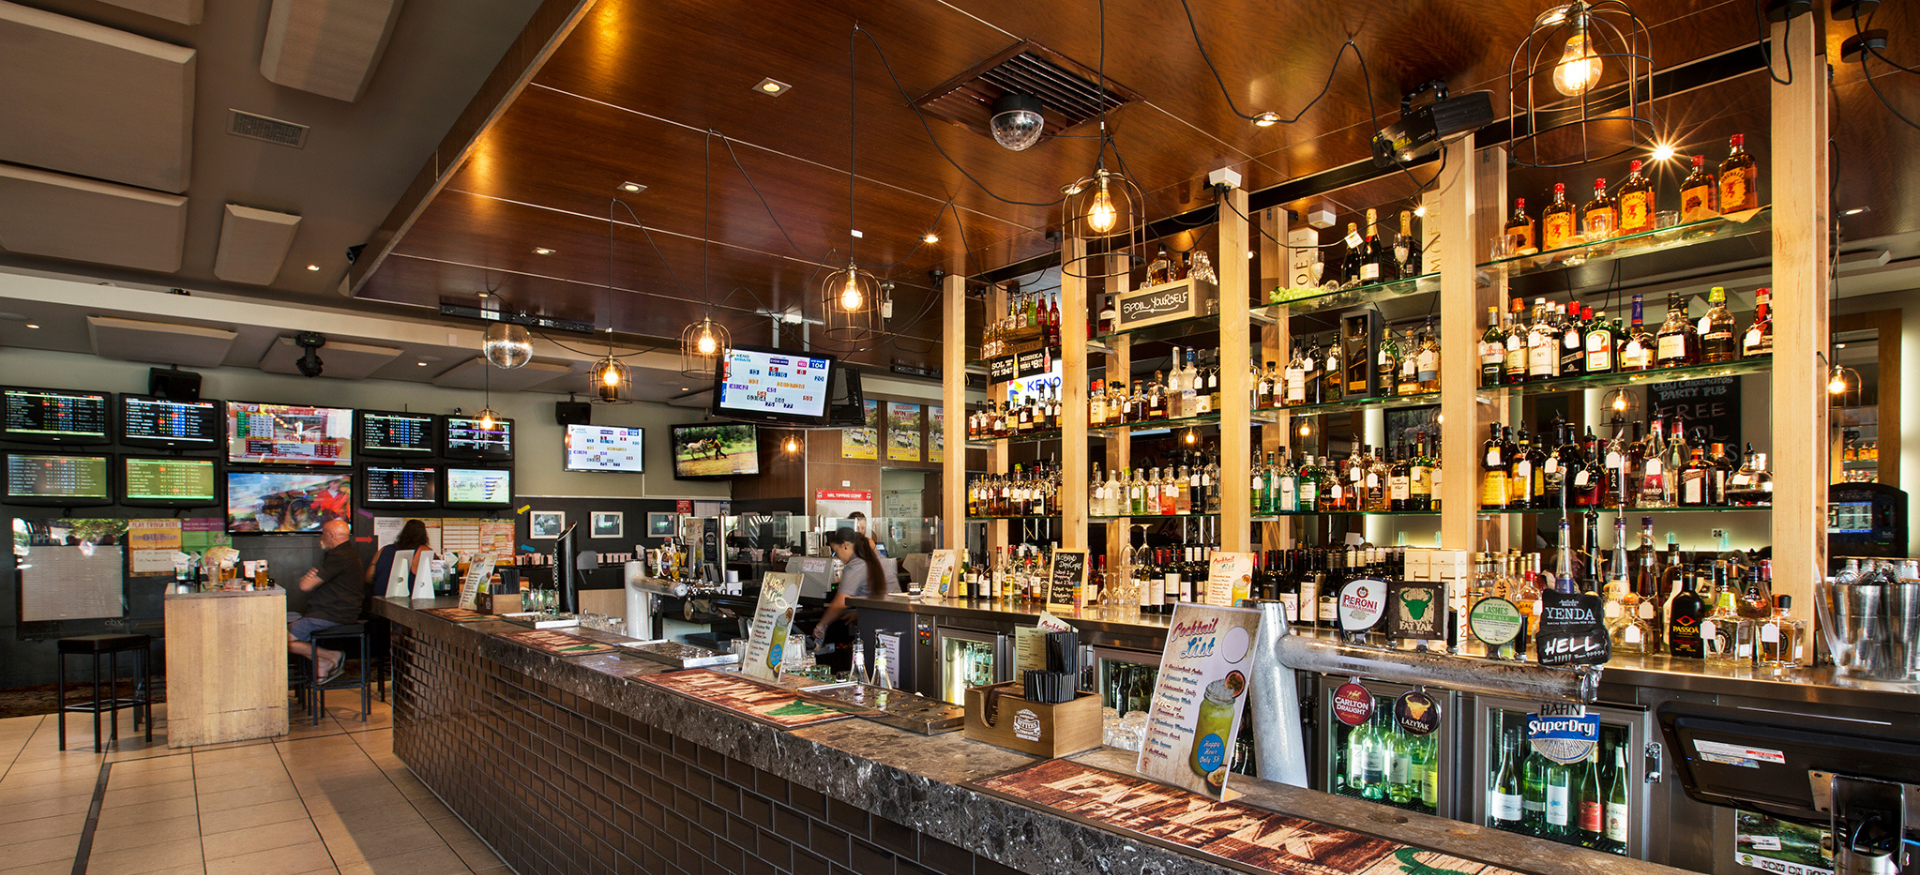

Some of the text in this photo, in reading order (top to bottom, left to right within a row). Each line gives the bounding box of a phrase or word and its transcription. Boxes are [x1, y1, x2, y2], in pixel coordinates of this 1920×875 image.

[1123, 291, 1189, 314] SPOIL YOURSELF
[991, 361, 1005, 370] SOL
[1027, 376, 1061, 392] KENO
[1660, 385, 1727, 401] PARTY PUB
[1343, 594, 1378, 610] PERONI
[1483, 605, 1509, 616] LASHES
[1545, 606, 1596, 621] YENDA
[1171, 617, 1219, 642] Cocktail
[1179, 637, 1216, 659] List
[1544, 635, 1601, 656] HELL
[1335, 696, 1369, 710] CARLTON
[1336, 703, 1366, 716] DRAUGHT
[1540, 704, 1580, 716] HAHN
[1076, 802, 1219, 844] PALE ALE
